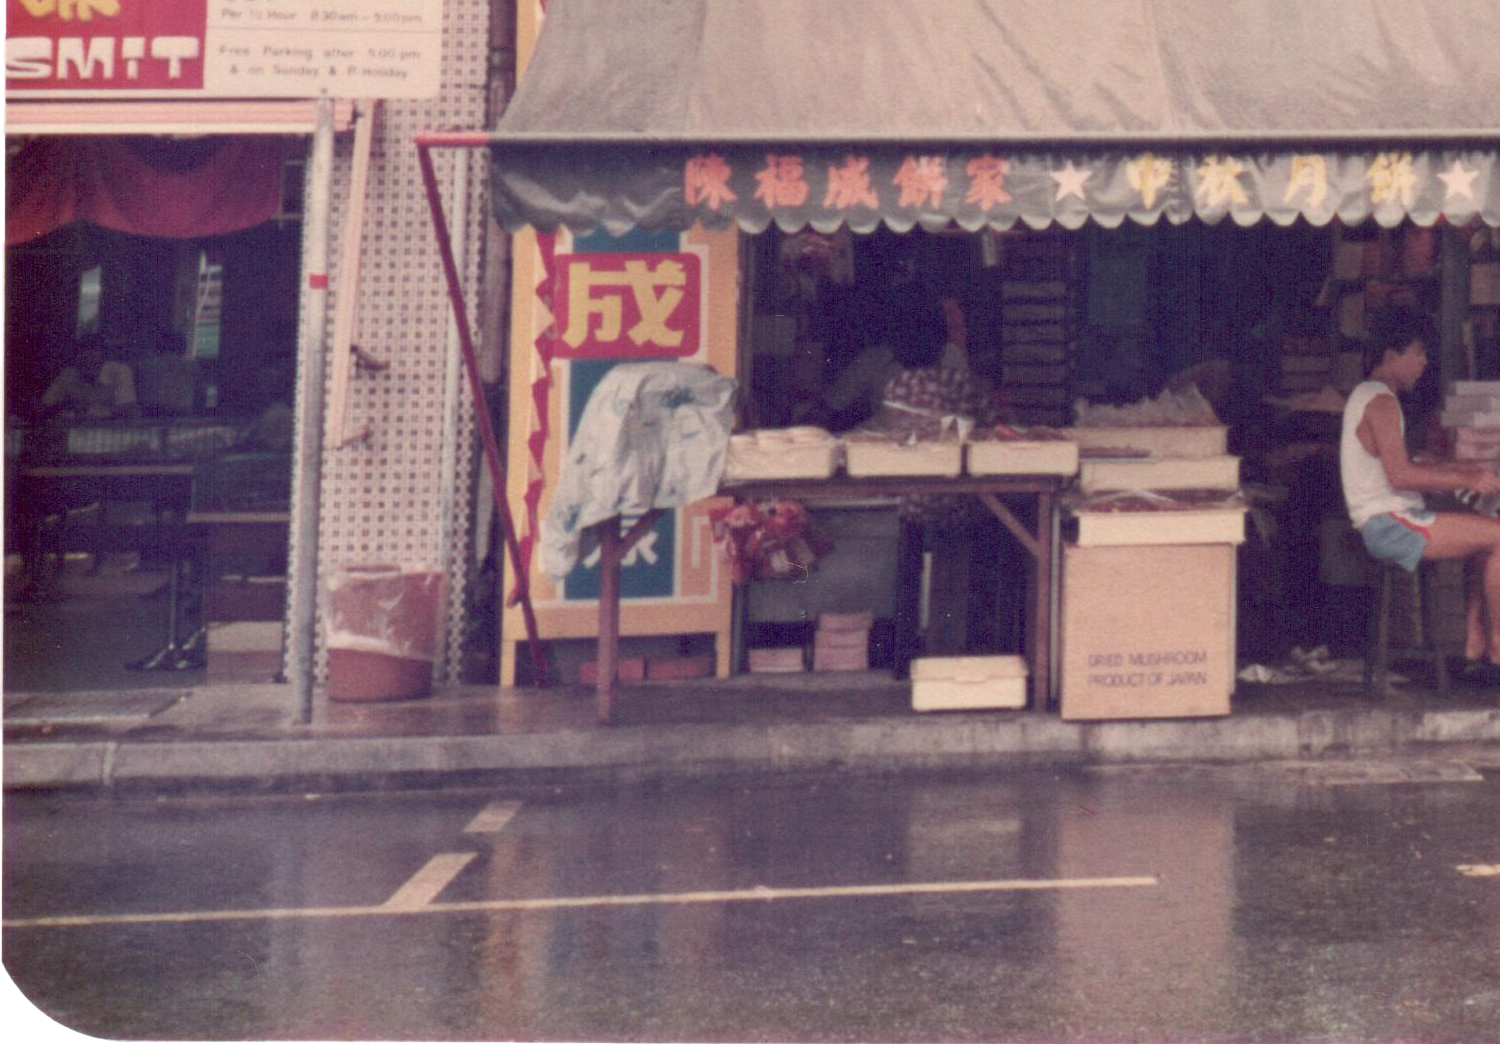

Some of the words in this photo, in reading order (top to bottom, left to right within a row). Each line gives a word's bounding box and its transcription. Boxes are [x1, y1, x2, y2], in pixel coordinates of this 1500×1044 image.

[221, 8, 242, 19] Per
[267, 9, 296, 20] Hour
[219, 45, 250, 56] Free
[263, 45, 313, 61] Parking
[323, 48, 355, 58] after
[273, 64, 319, 78] Sunday
[562, 259, 687, 349] 成
[1088, 653, 1124, 667] DRIED
[1129, 650, 1208, 666] MUSHROOM
[1088, 673, 1145, 687] PRODUCT
[1148, 672, 1164, 686] OF
[1166, 671, 1208, 686] JAPAN
